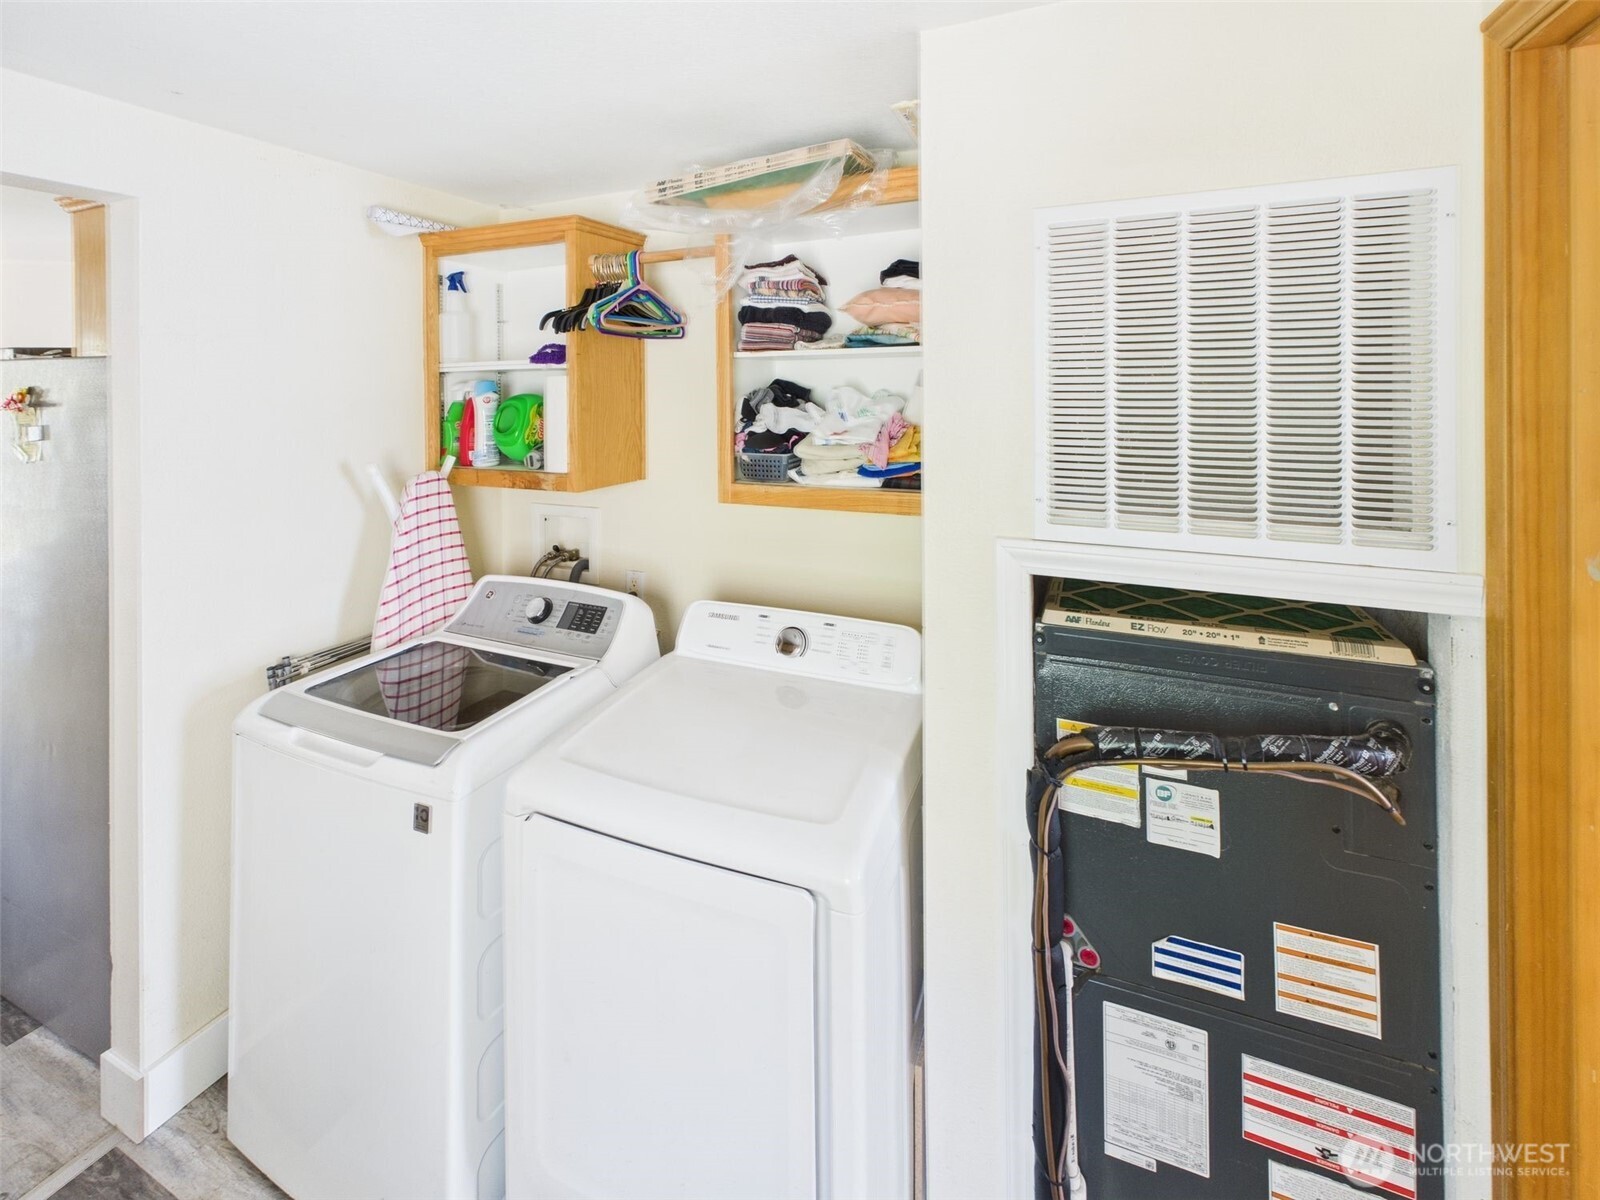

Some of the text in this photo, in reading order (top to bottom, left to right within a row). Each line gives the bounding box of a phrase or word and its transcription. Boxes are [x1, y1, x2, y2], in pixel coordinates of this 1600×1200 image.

[708, 611, 740, 621] SAMSUNG
[1065, 615, 1082, 624] AAF
[1130, 622, 1145, 631] EZ
[1147, 623, 1169, 634] Flow
